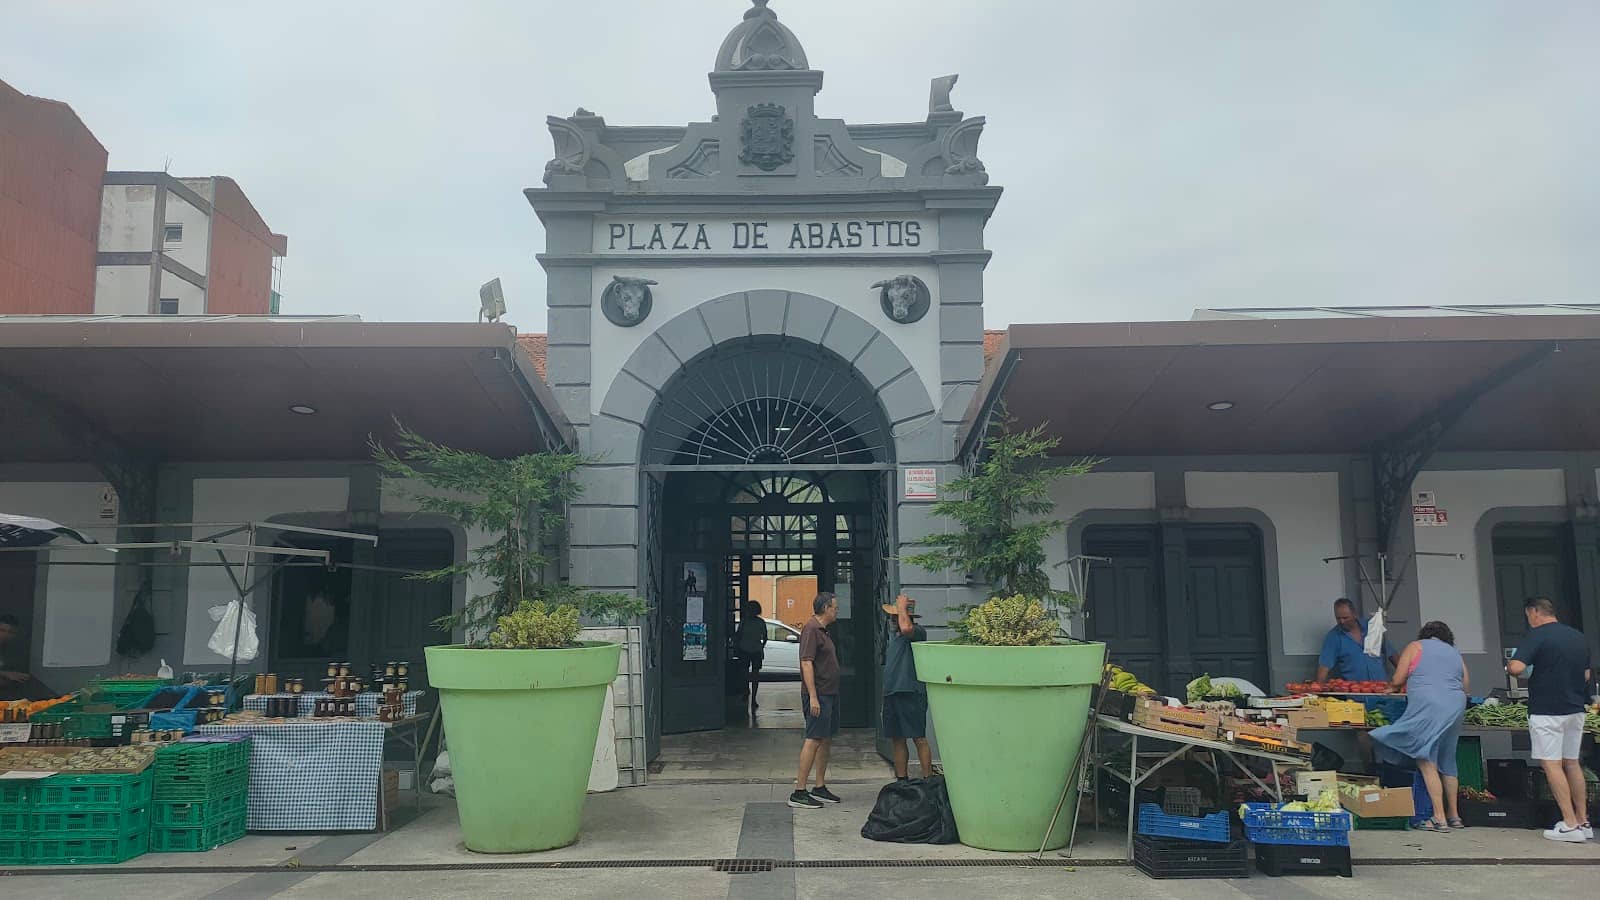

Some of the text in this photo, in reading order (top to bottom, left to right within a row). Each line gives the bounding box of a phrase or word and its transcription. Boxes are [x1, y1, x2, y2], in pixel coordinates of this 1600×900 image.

[608, 220, 922, 250] PLAZA DE ABASTOS
